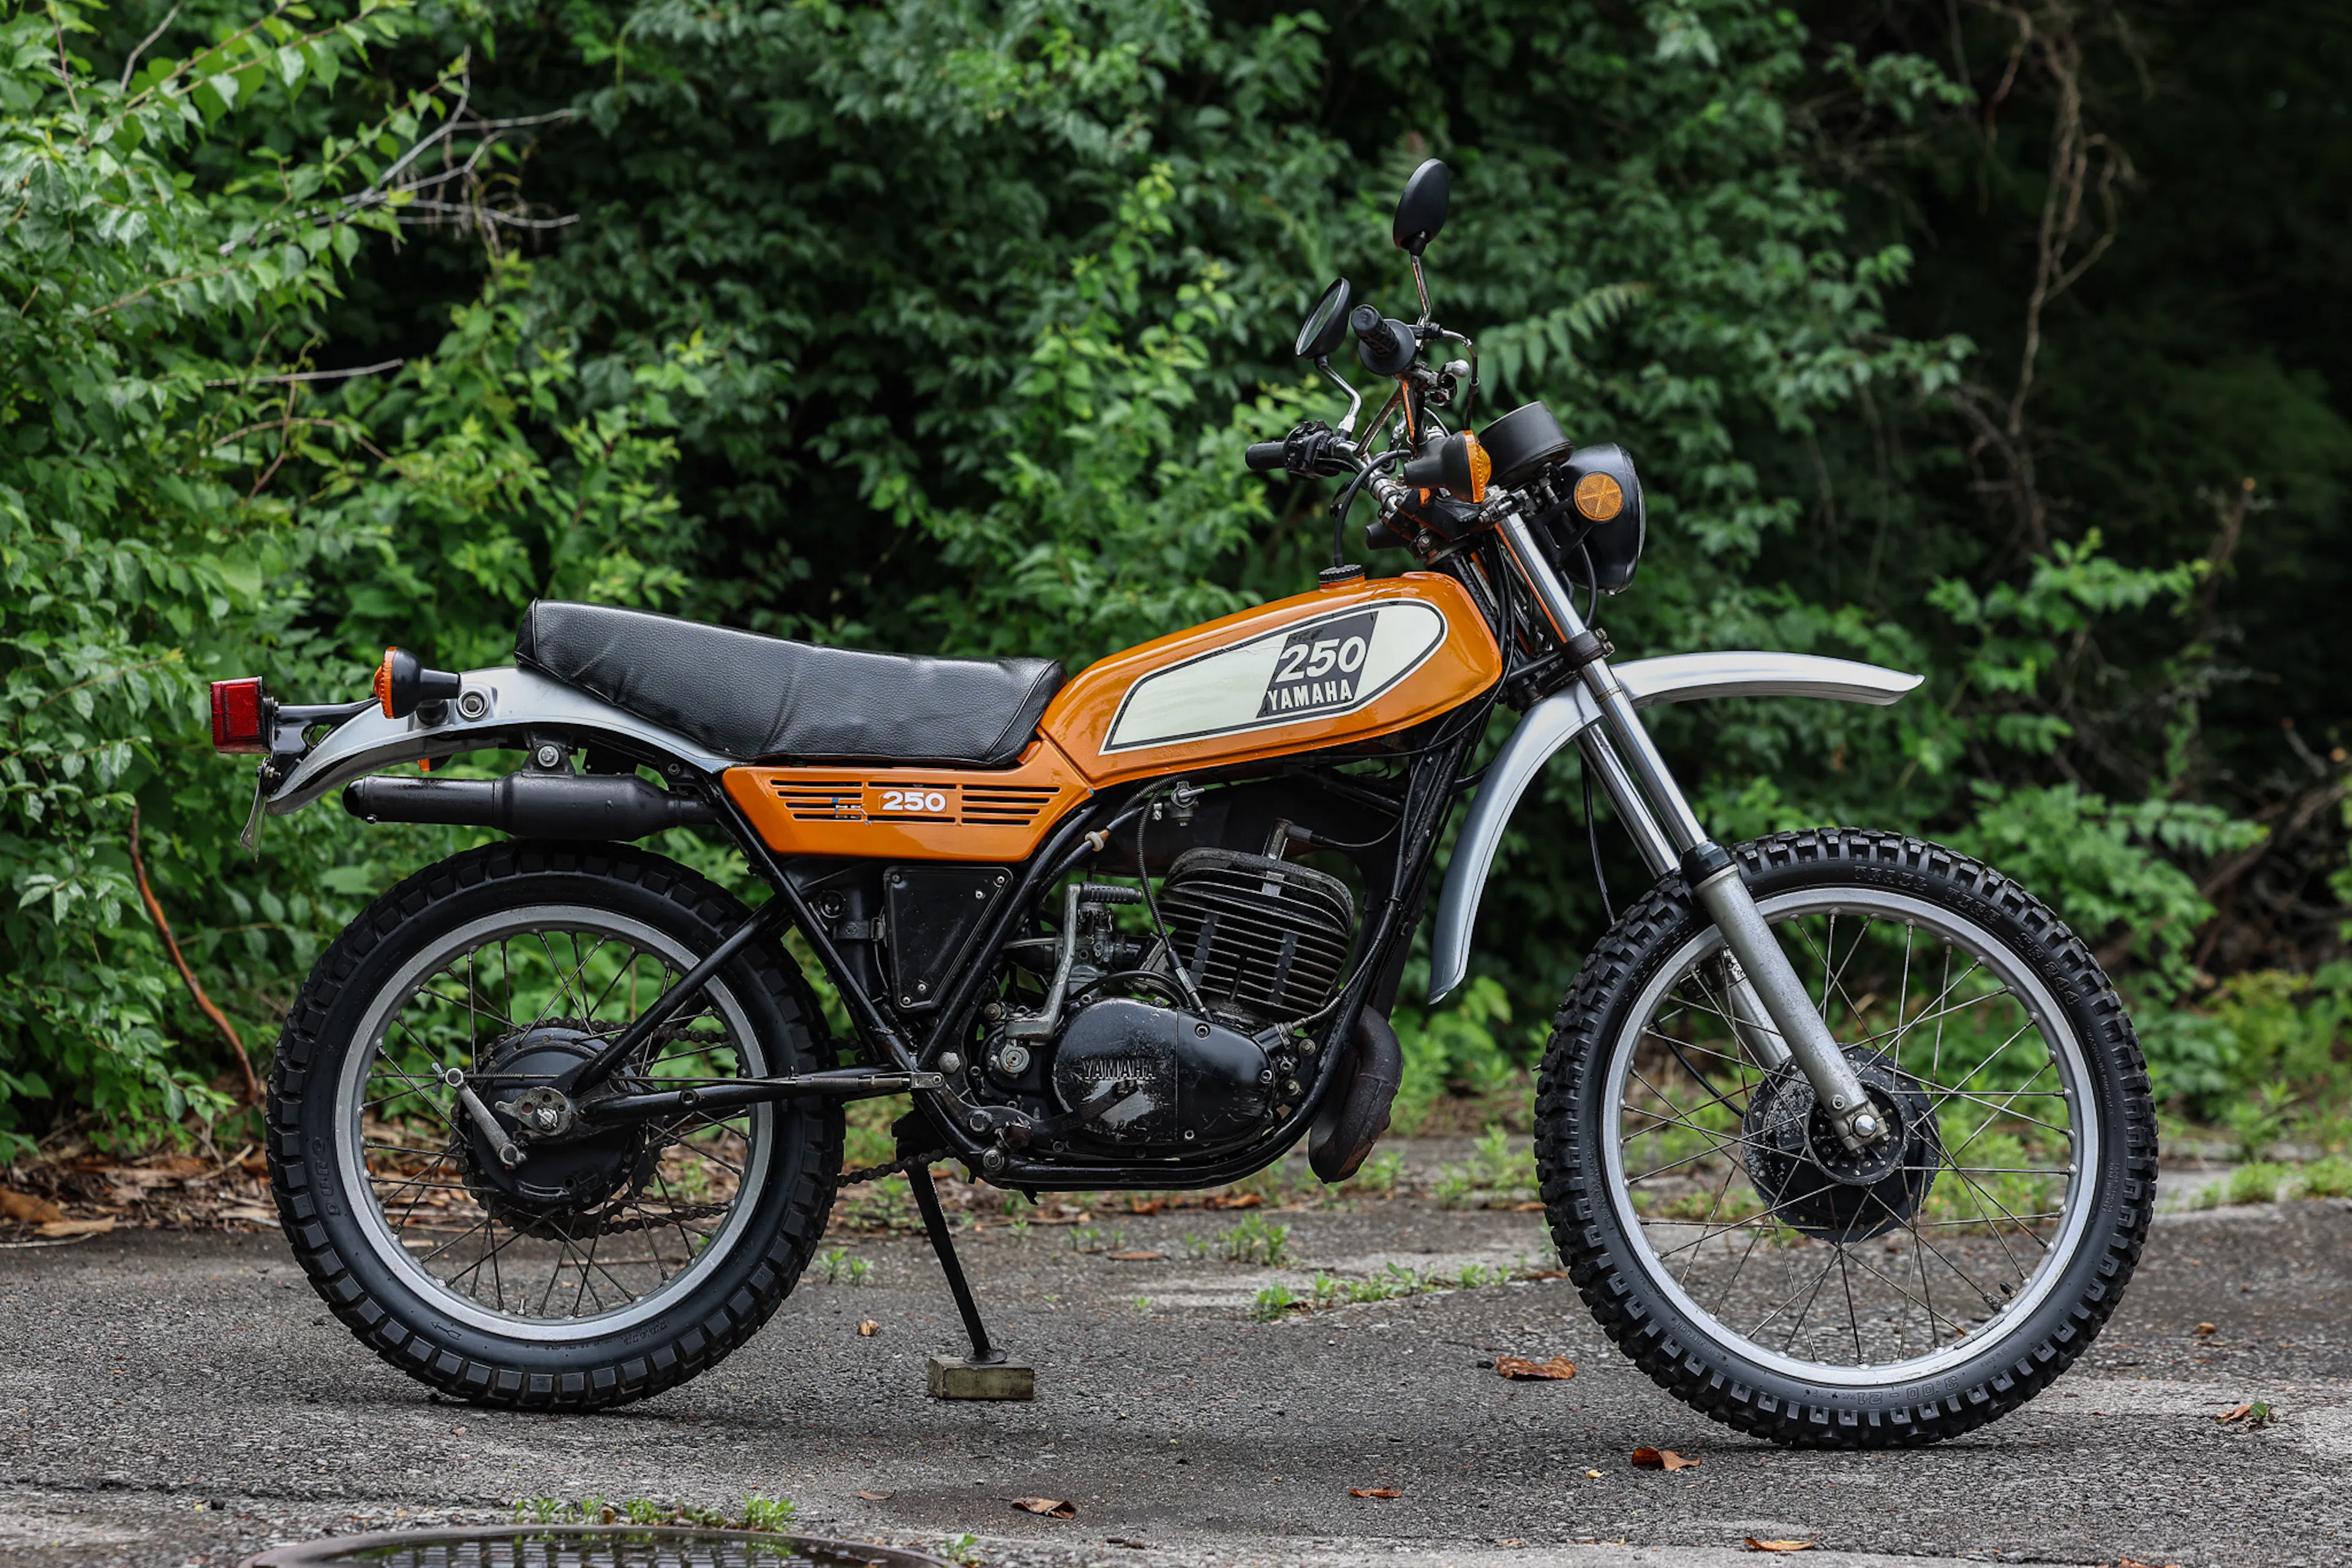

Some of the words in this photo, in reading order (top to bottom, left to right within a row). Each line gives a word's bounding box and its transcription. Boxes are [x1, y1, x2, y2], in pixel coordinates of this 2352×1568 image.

[1276, 636, 1367, 683] 250
[1267, 679, 1354, 711] YAMAHA
[882, 791, 946, 812] 250
[1083, 1060, 1156, 1080] YAMAHA
[312, 1138, 341, 1216] DURO
